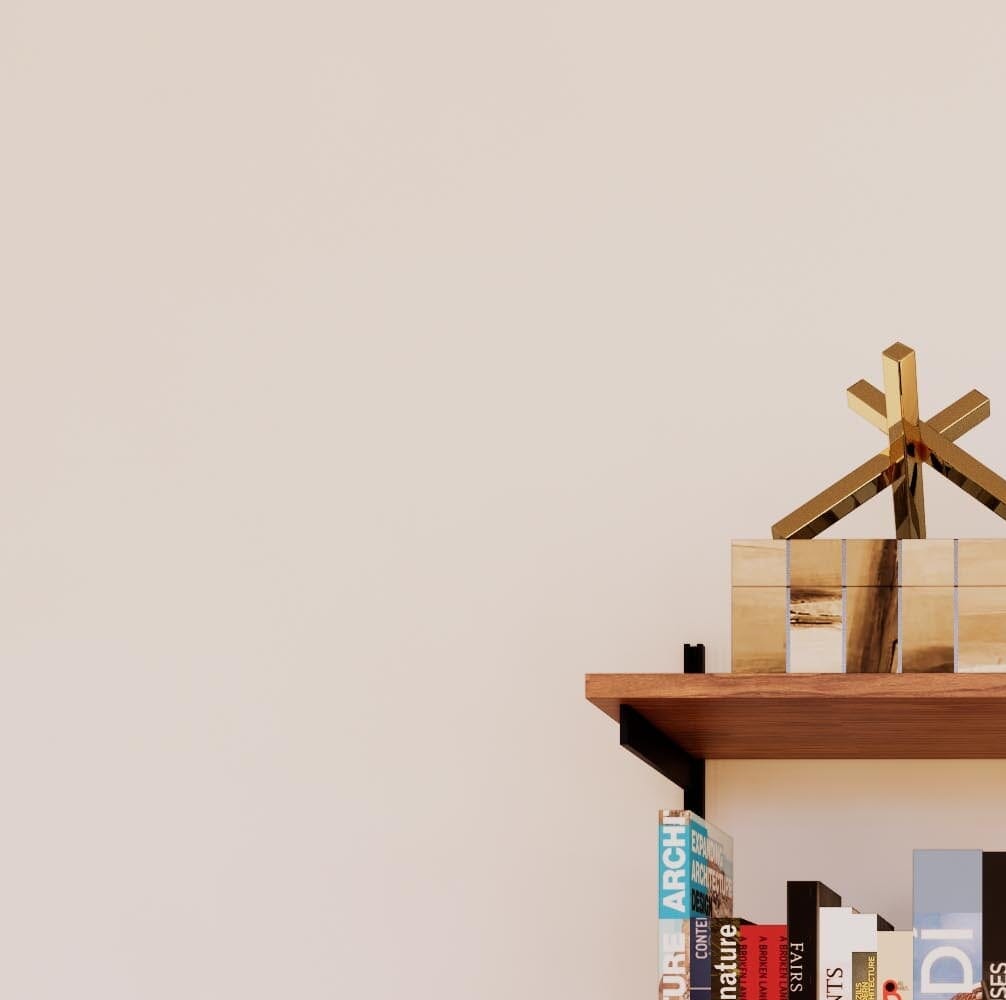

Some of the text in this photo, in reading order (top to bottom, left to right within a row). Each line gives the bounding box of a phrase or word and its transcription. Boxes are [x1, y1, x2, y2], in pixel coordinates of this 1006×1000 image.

[695, 918, 708, 960] CONTE
[759, 944, 768, 978] BROKEN
[779, 944, 787, 978] BROKEN
[790, 942, 804, 992] FAIRS
